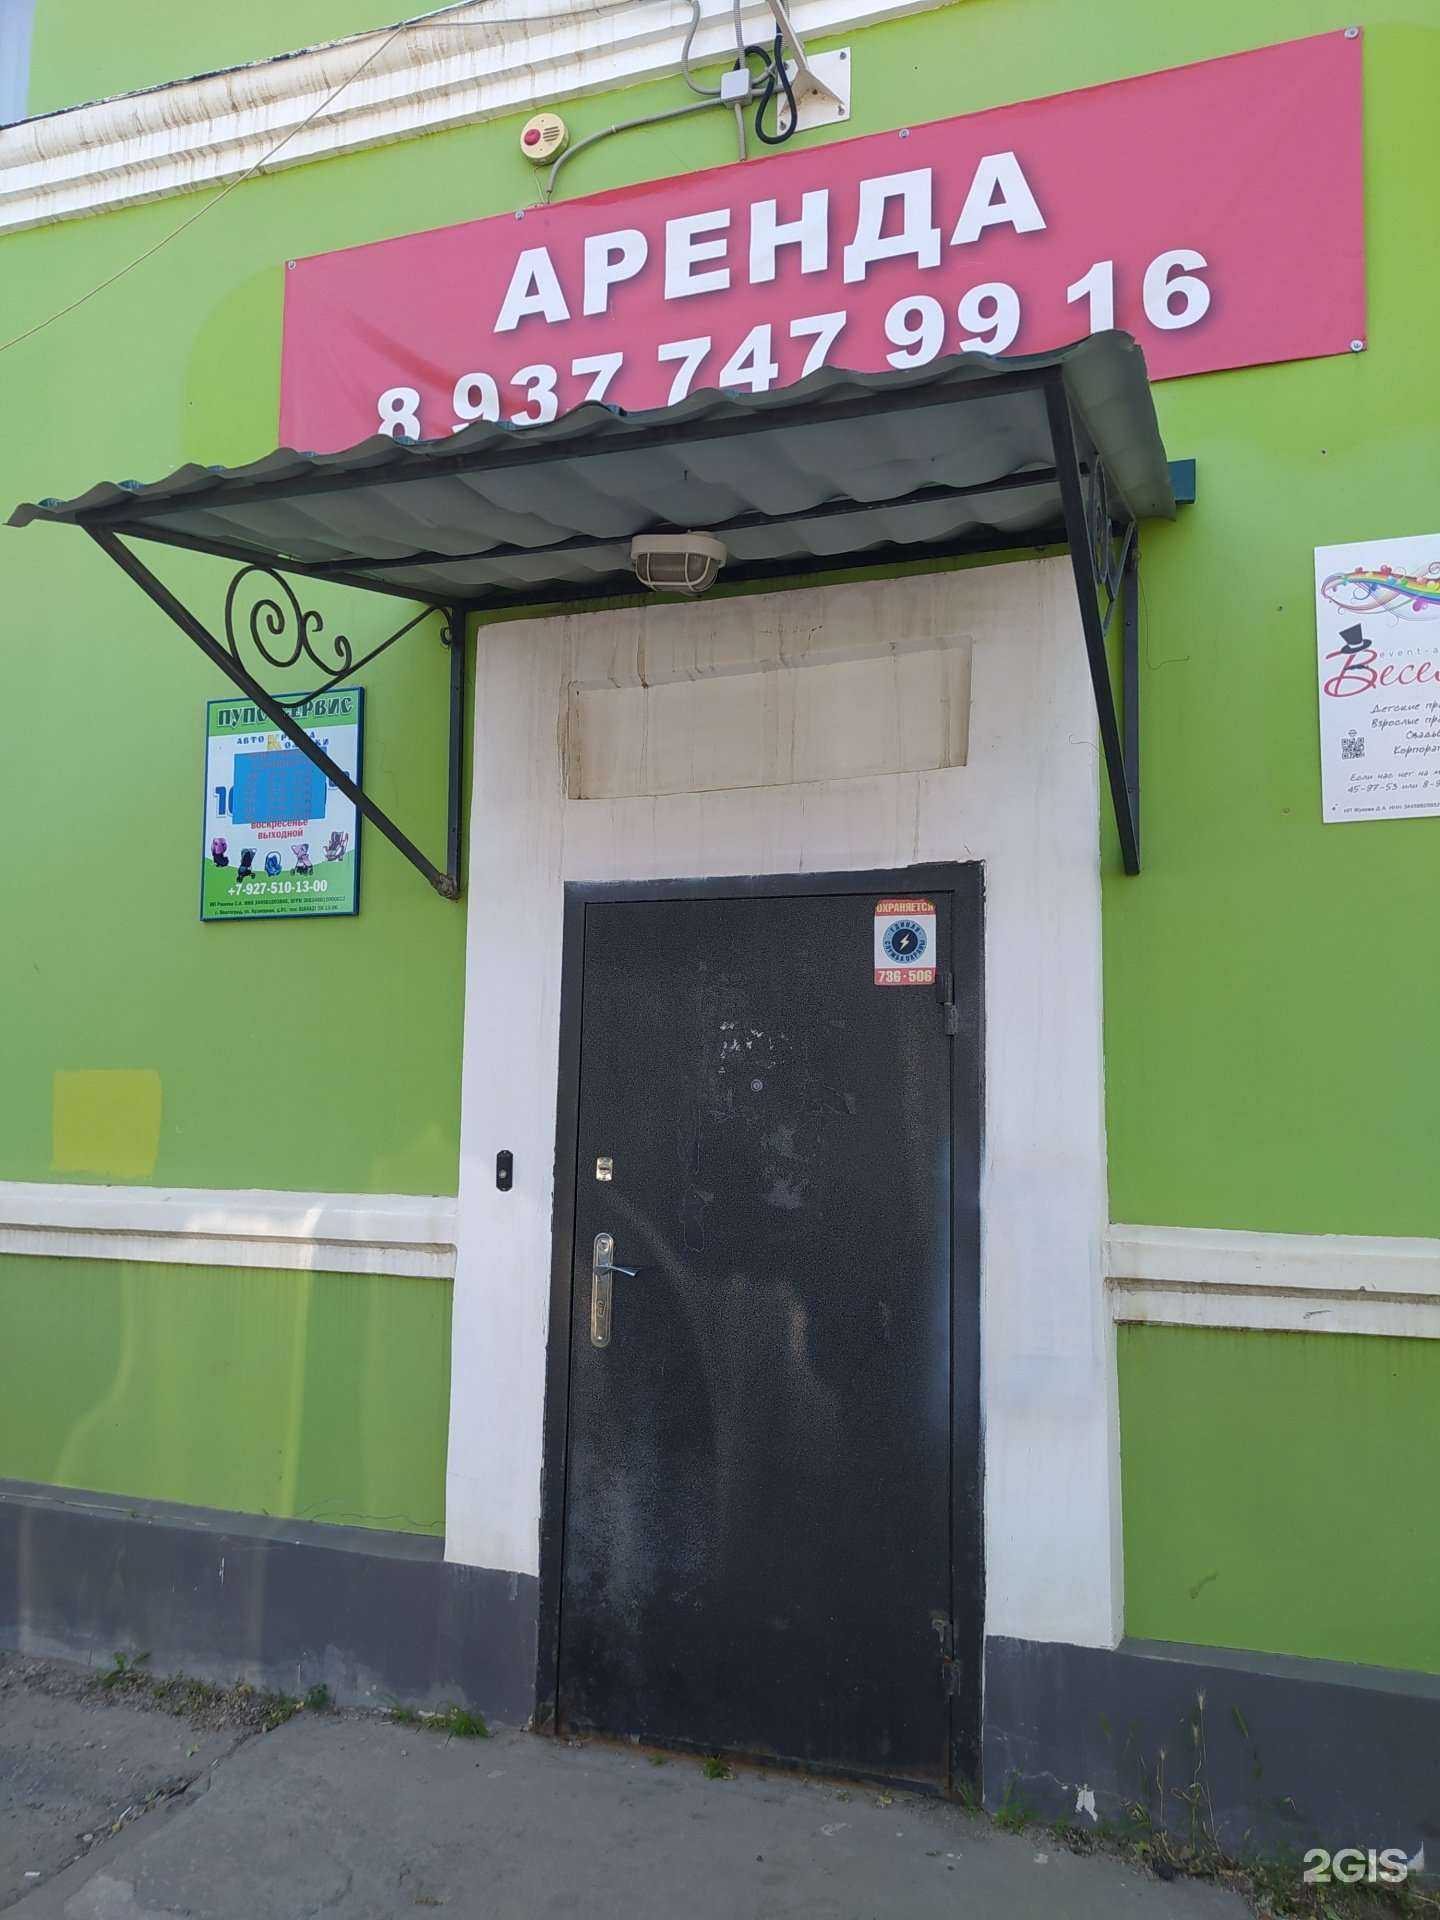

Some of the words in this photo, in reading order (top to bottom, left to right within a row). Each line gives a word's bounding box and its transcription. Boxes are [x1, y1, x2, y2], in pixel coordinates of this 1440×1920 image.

[495, 151, 1047, 333] АРЕНДА
[377, 387, 420, 440] 8
[452, 351, 623, 432] 937
[657, 310, 847, 408] 747
[884, 282, 1021, 370] 99
[1067, 249, 1211, 334] 16
[285, 697, 353, 719] ЕРВИС
[228, 880, 328, 896] +7-927-510-13-00
[876, 902, 934, 912] ОХРАНЯЕТСЯ
